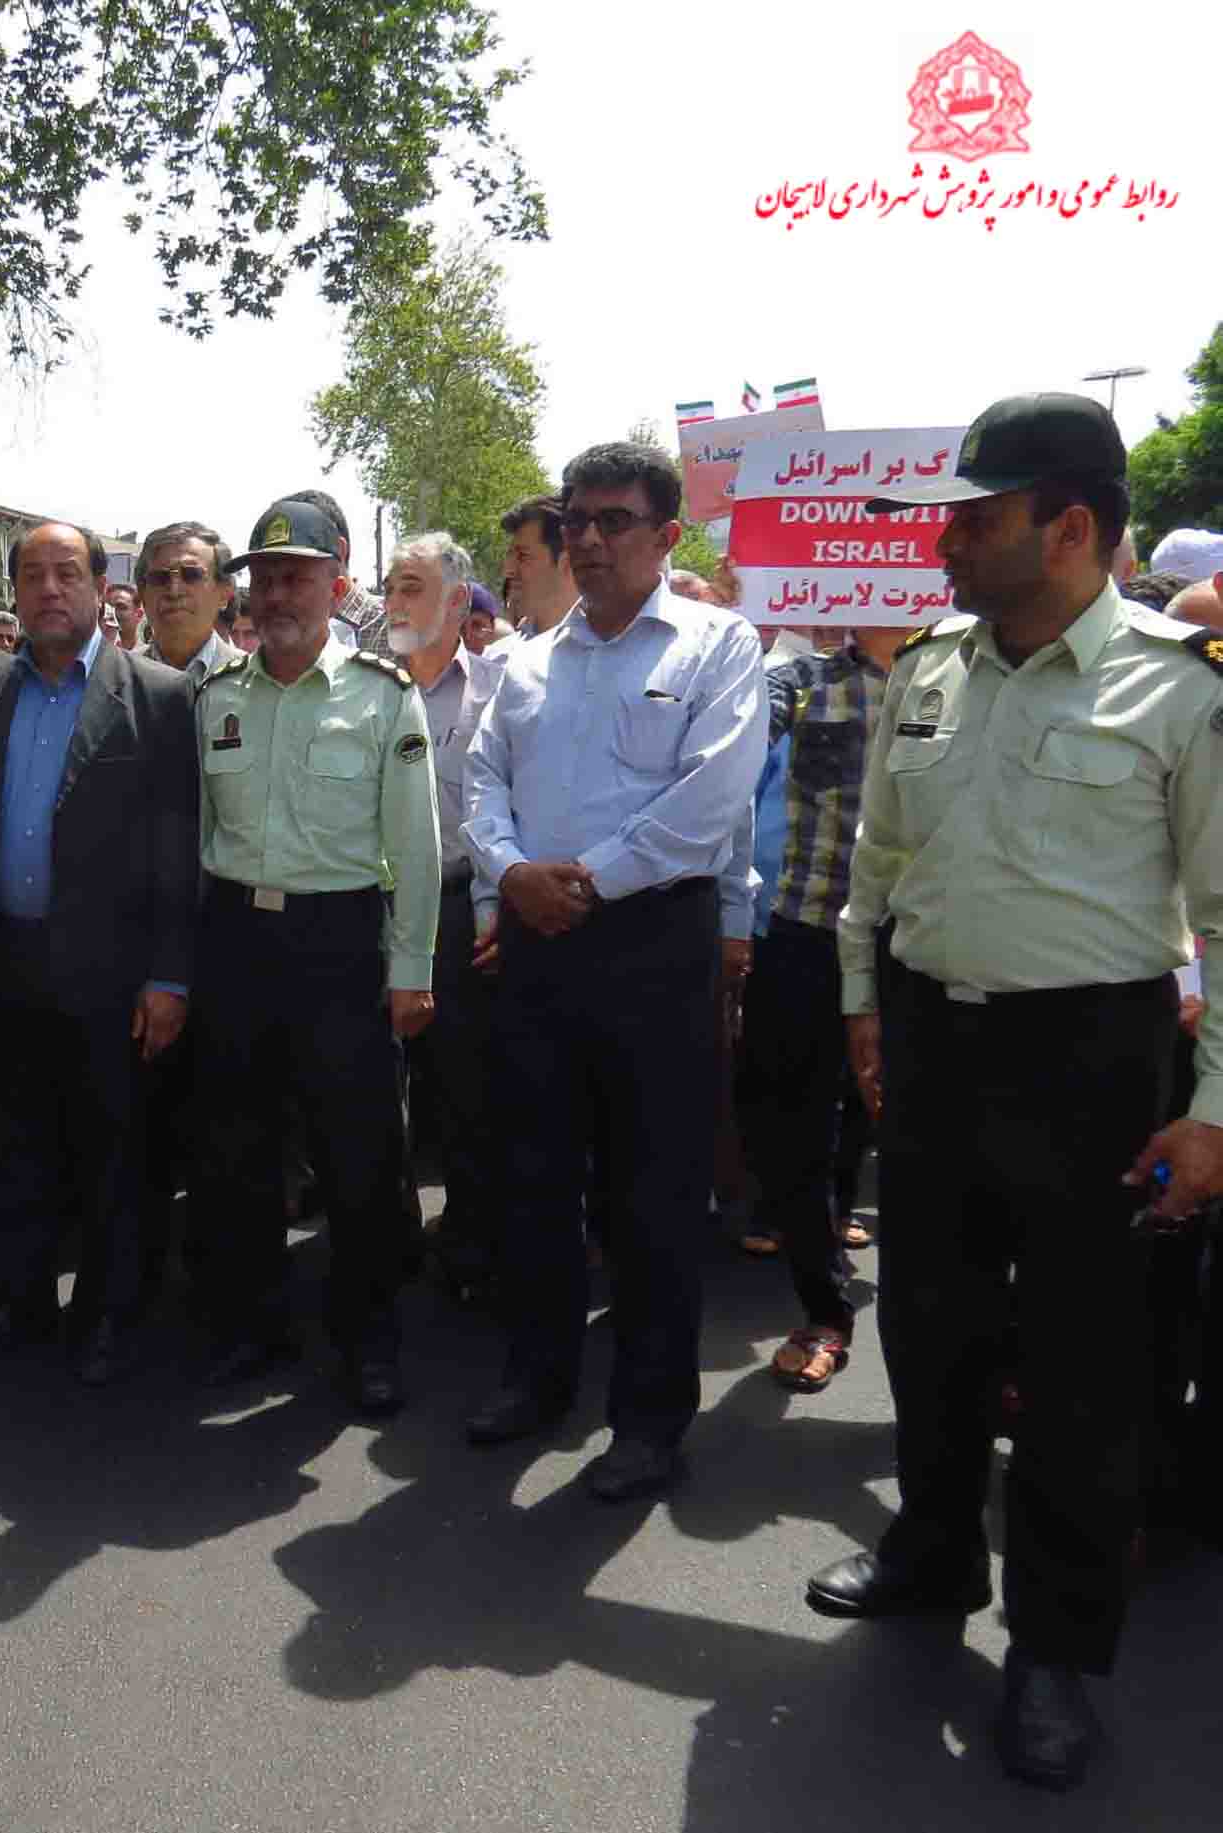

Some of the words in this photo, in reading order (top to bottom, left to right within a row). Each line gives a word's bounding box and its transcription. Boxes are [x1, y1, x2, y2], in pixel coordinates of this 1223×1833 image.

[775, 448, 873, 486] اسرائیل
[877, 456, 906, 486] بر
[780, 502, 875, 523] DOWN
[889, 502, 954, 523] WIT
[812, 541, 924, 562] ISRAEL
[767, 577, 875, 613] لاسرائیل
[882, 577, 955, 615] لموت
